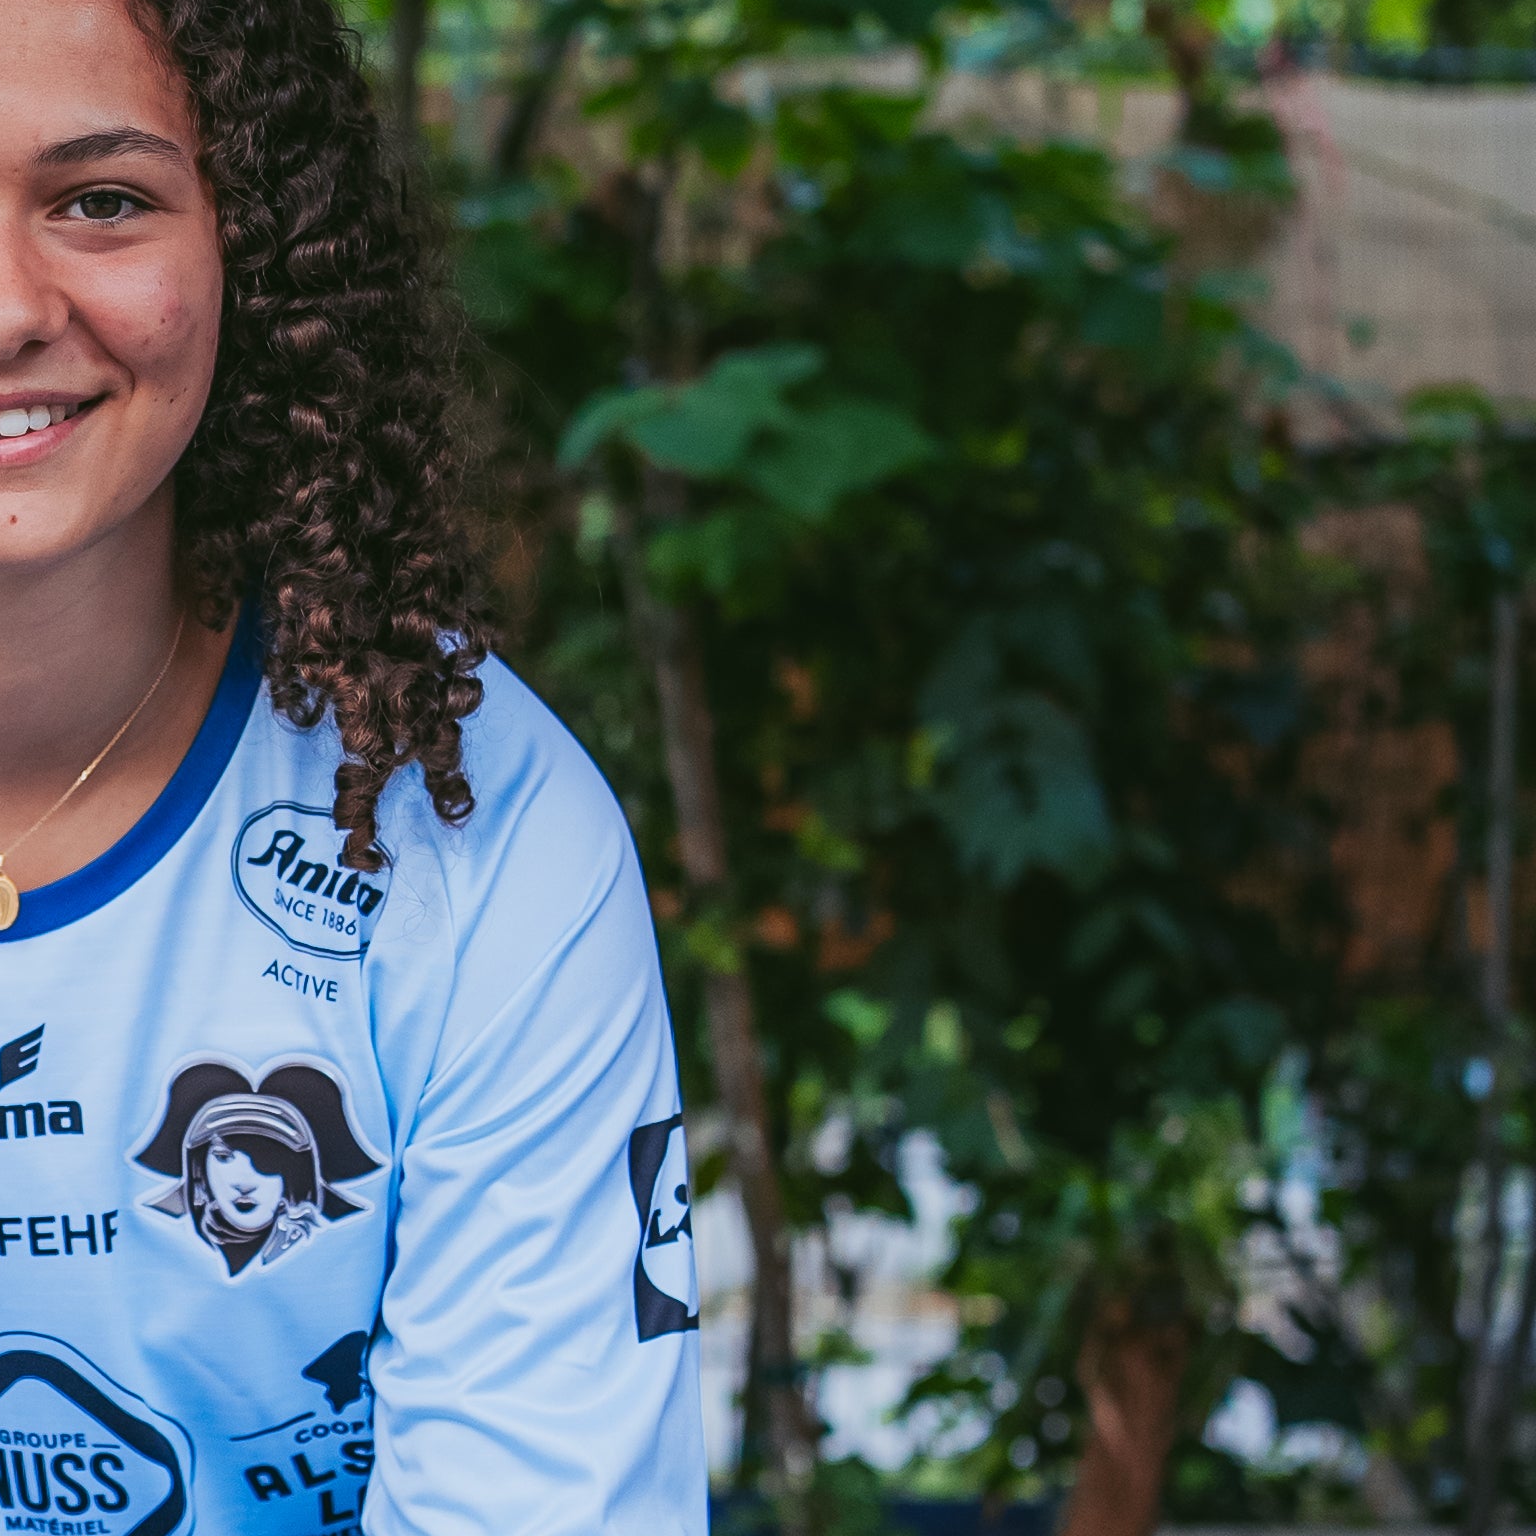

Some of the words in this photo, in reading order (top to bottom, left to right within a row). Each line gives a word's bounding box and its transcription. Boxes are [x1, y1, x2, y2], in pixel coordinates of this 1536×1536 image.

[321, 908, 357, 936] 1886
[261, 959, 338, 1002] ACTIVE
[4, 1516, 110, 1536] MATÉRIEL
